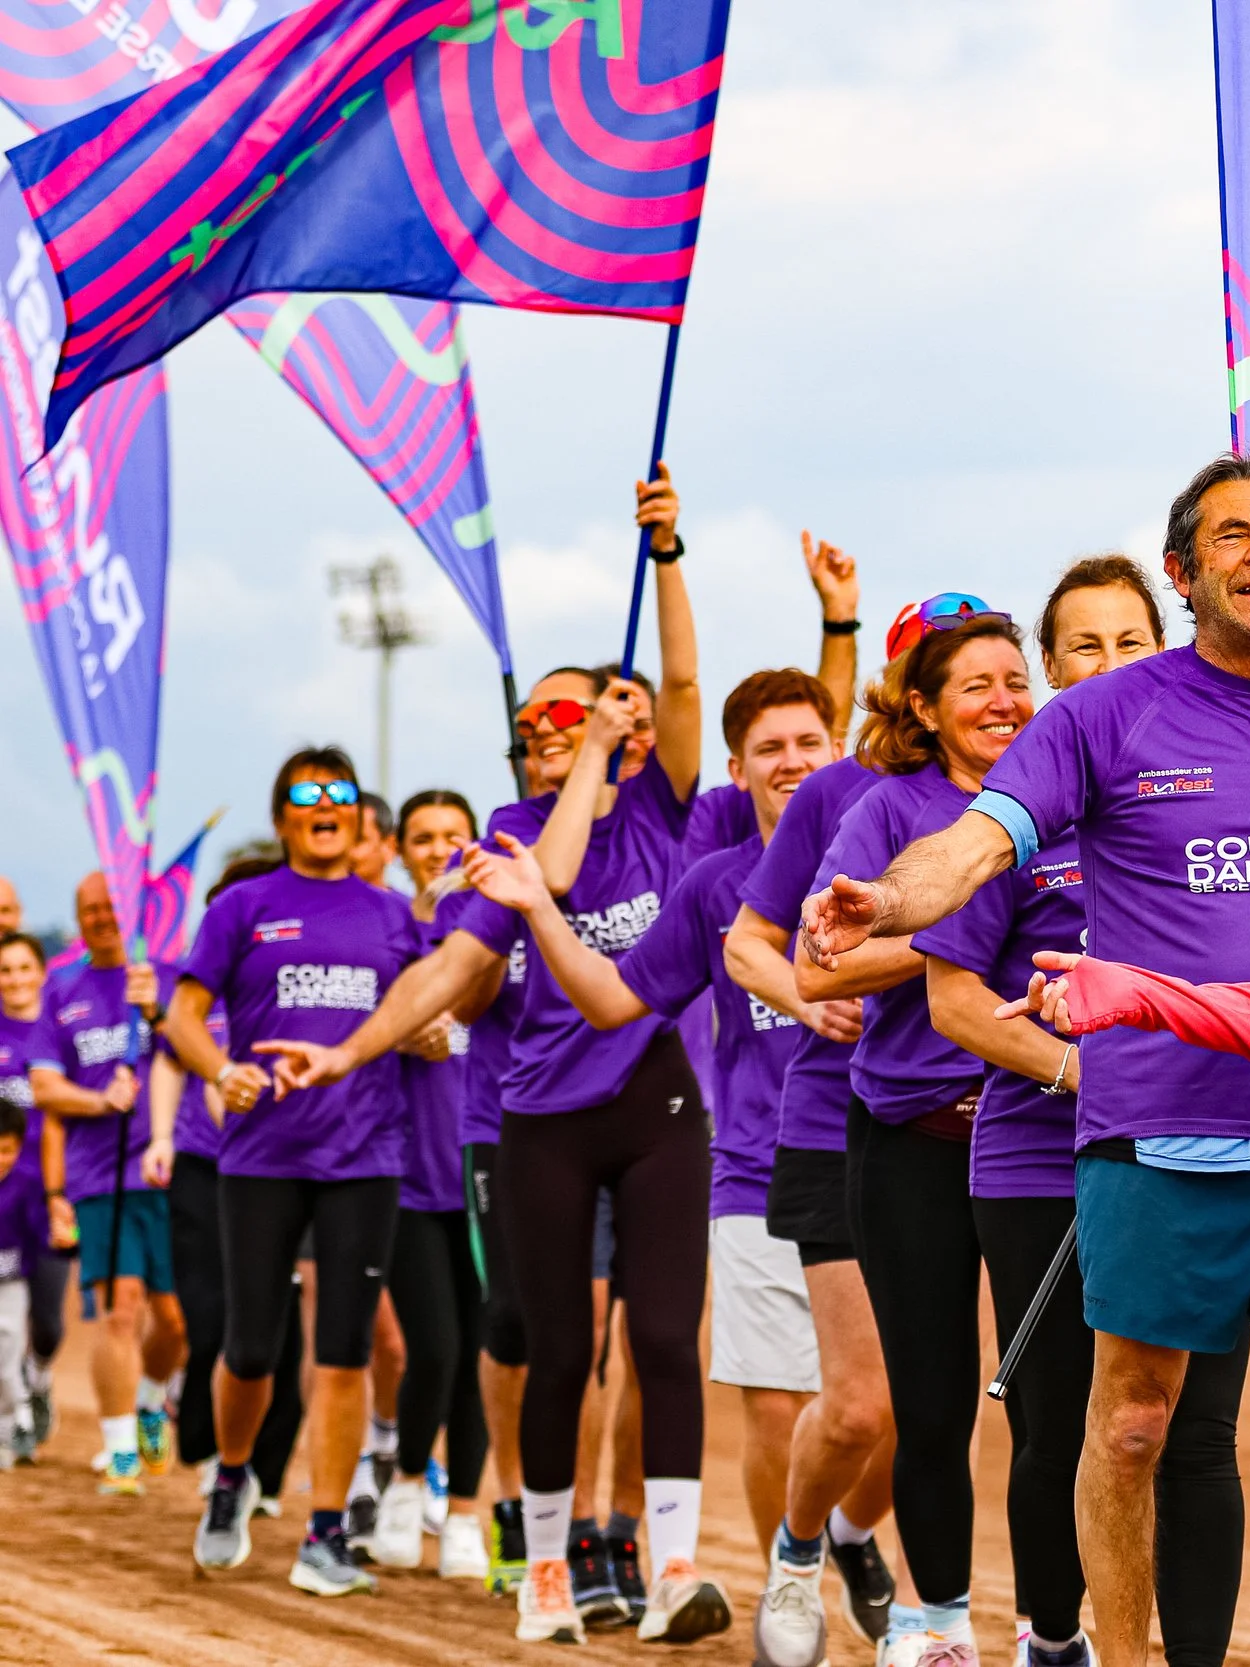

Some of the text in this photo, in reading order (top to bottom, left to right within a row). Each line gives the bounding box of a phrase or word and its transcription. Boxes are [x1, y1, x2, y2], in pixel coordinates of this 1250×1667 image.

[1138, 766, 1213, 779] Ambassadeur 2026
[1138, 777, 1214, 794] Runfest
[1031, 860, 1080, 875] Ambassadeur
[1189, 882, 1216, 894] SE
[753, 1018, 773, 1032] SE
